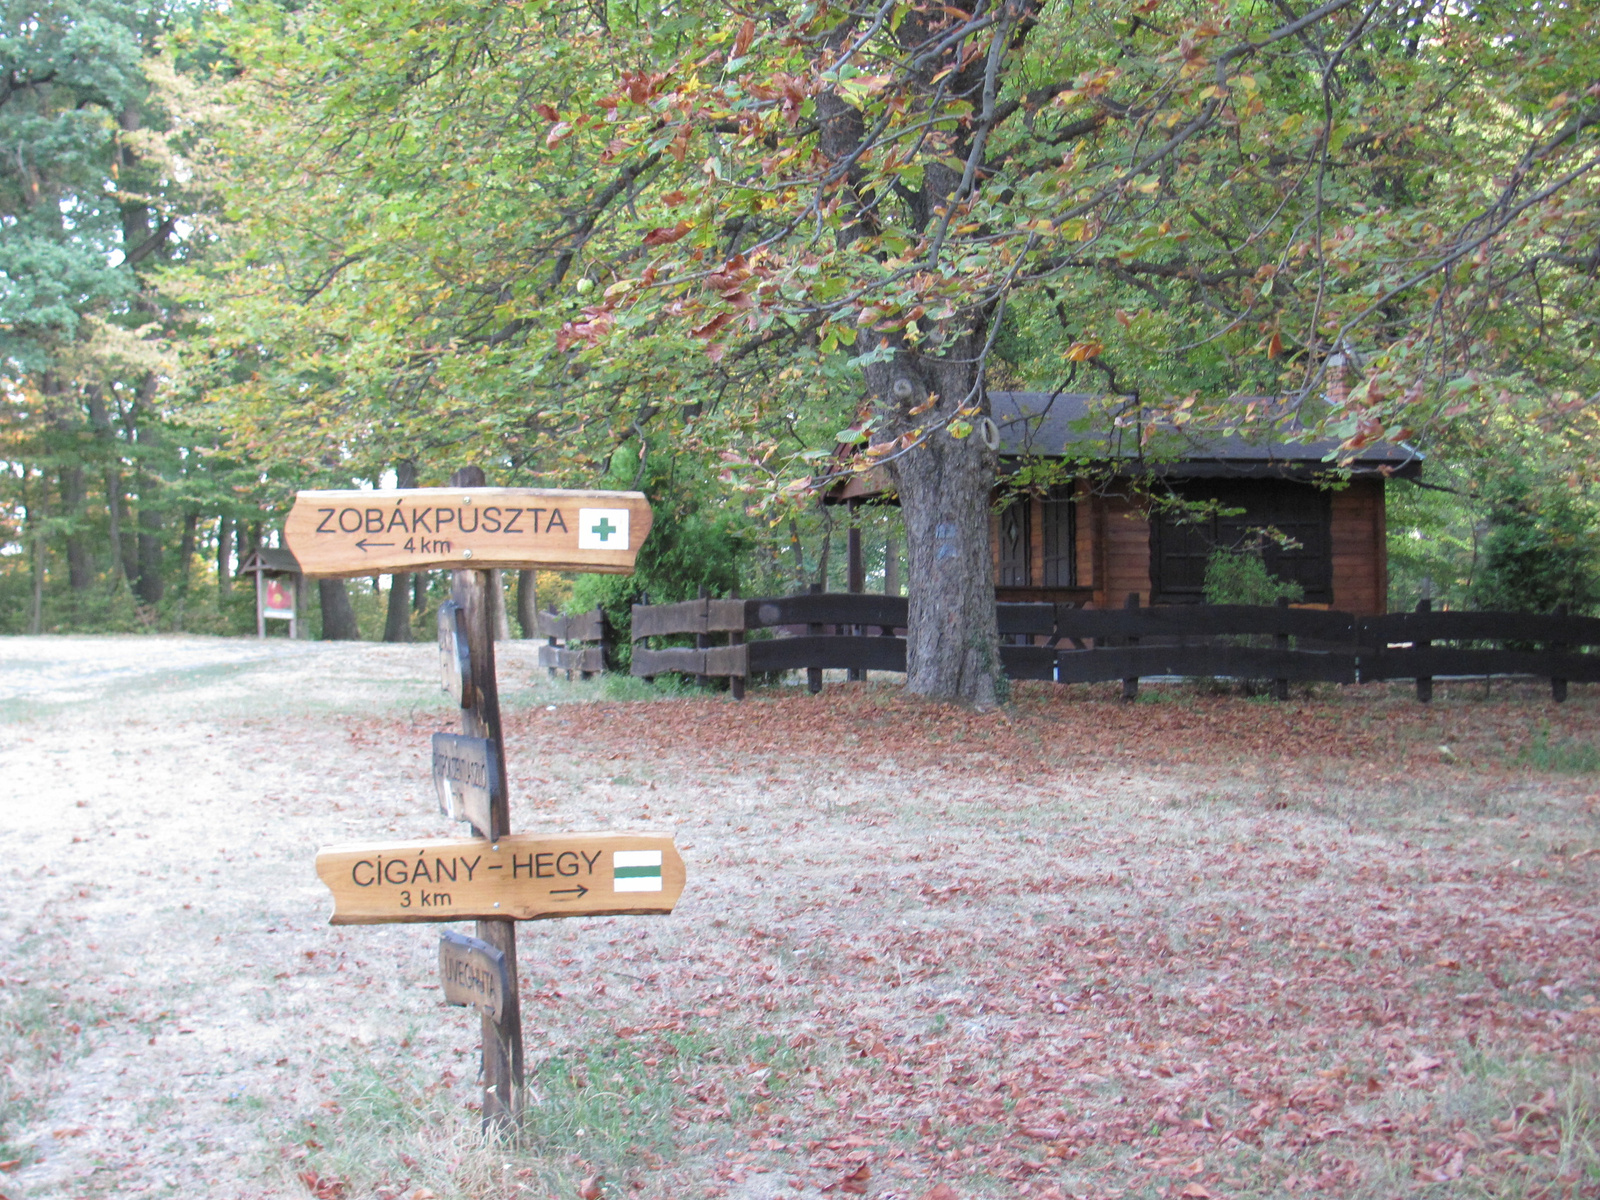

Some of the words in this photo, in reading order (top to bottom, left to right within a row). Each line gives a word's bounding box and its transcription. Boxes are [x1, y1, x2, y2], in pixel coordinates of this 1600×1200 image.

[315, 499, 569, 534] ZOBÁKPUSZTA
[513, 850, 603, 880] HEGY
[400, 891, 412, 908] 3
[420, 890, 452, 908] km
